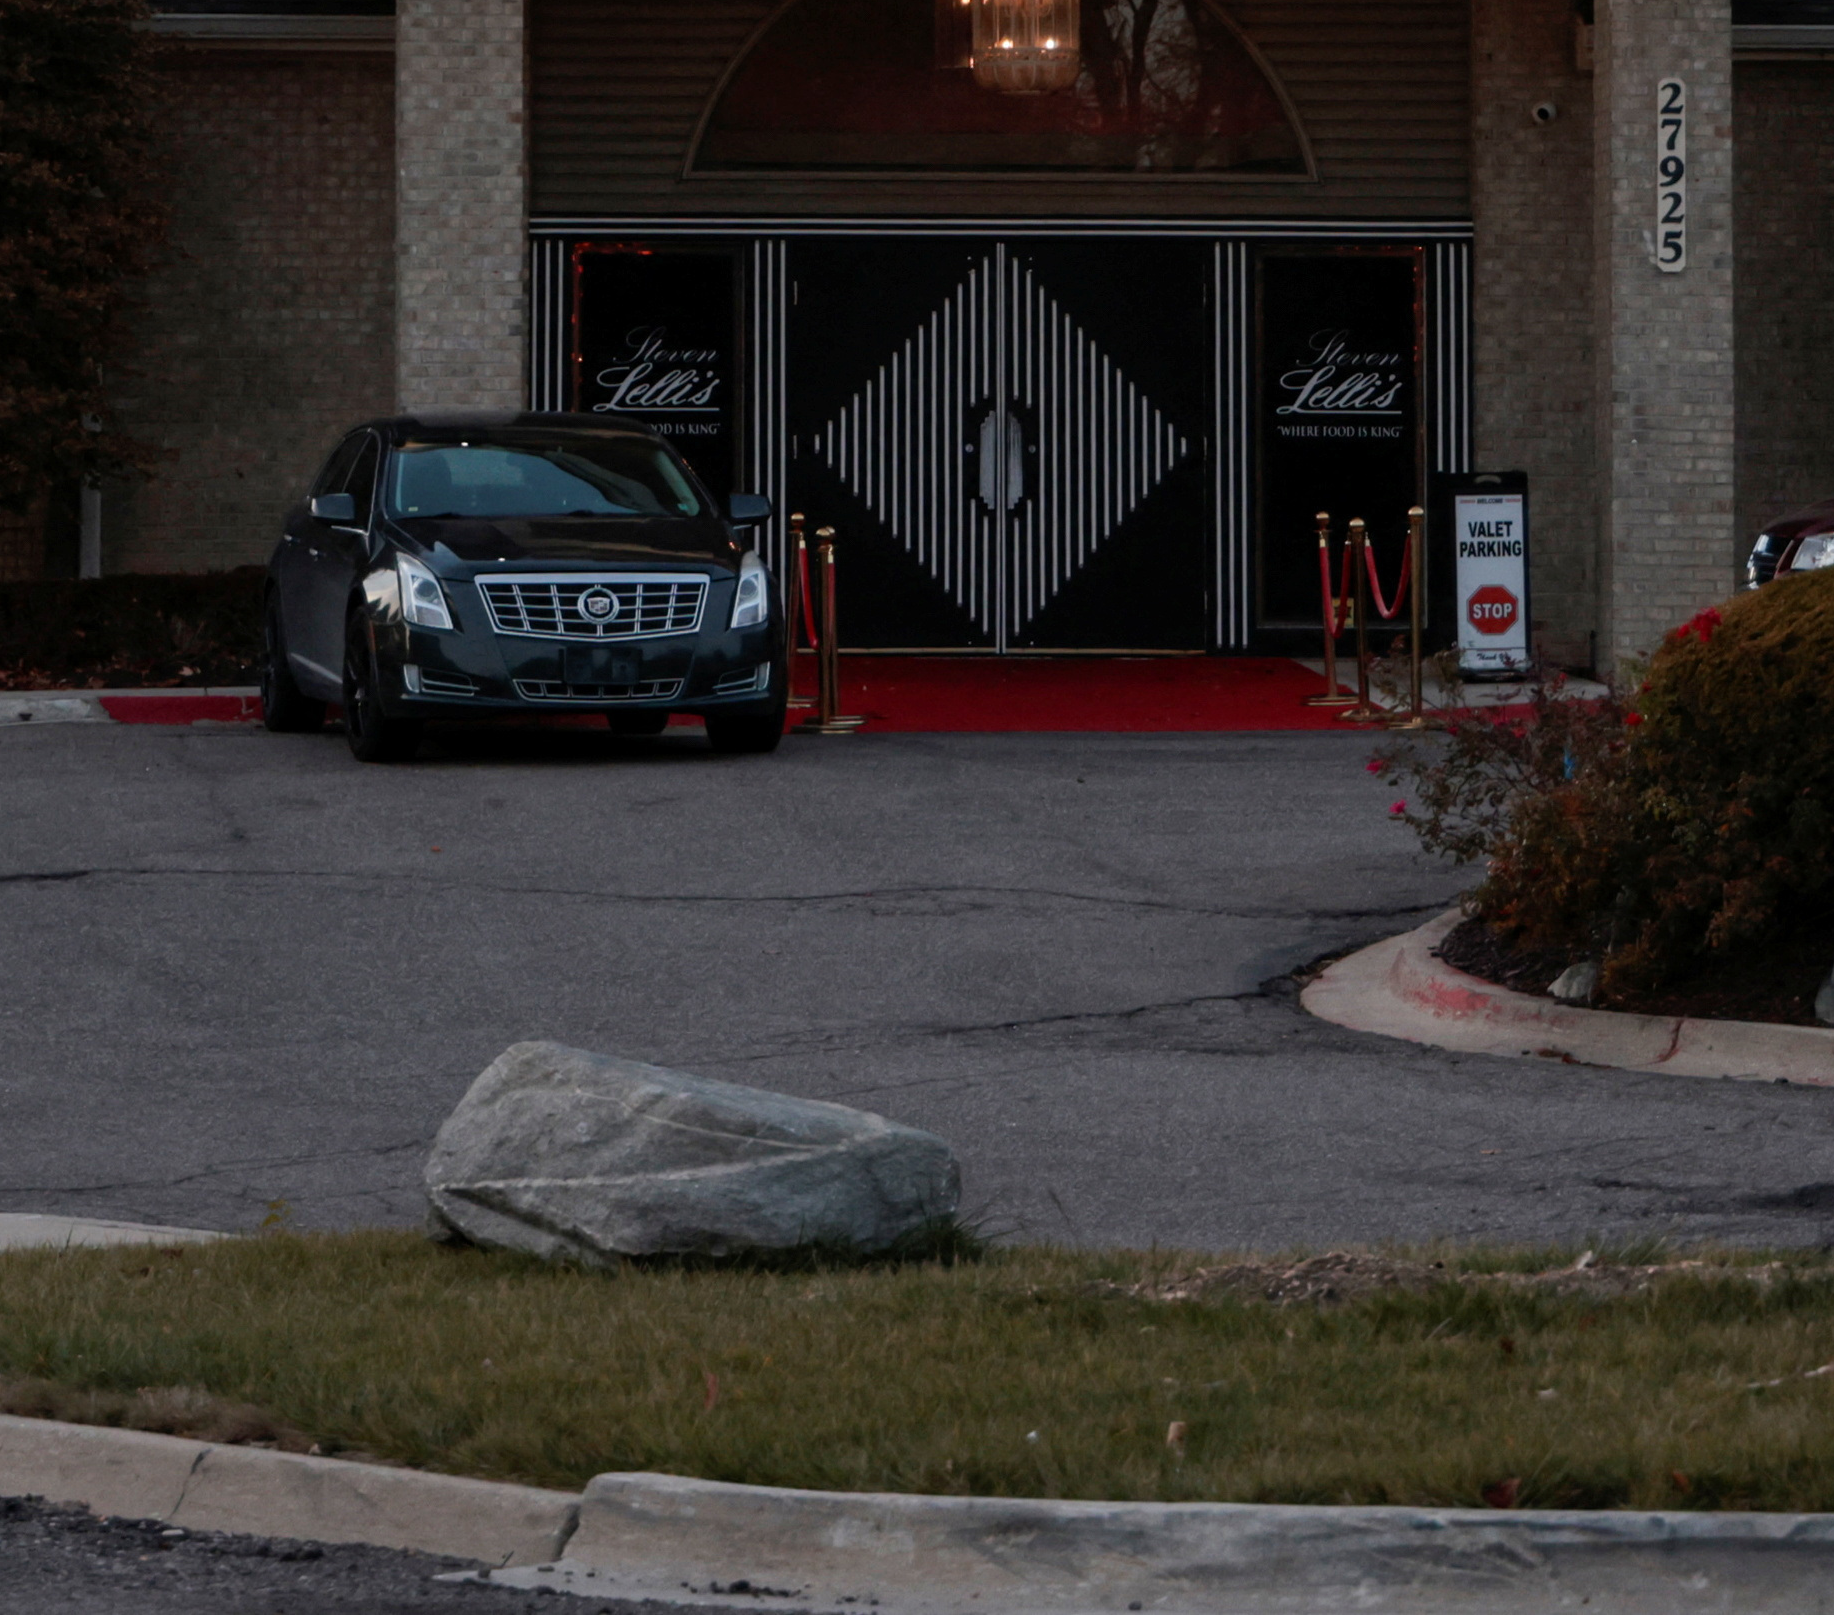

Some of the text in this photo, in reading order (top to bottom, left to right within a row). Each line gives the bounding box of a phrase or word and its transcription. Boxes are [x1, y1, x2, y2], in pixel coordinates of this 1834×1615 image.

[1659, 82, 1685, 264] 27925
[612, 326, 719, 364] Steven
[1295, 328, 1401, 366] Steven
[593, 362, 720, 412] Lelli's
[1276, 365, 1403, 415] Lelli's
[675, 423, 686, 435] IS
[1322, 425, 1355, 437] FOOD
[1357, 425, 1368, 437] IS
[1468, 520, 1513, 538] VALET
[1459, 540, 1522, 557] PARKING
[1472, 602, 1513, 619] STOP
